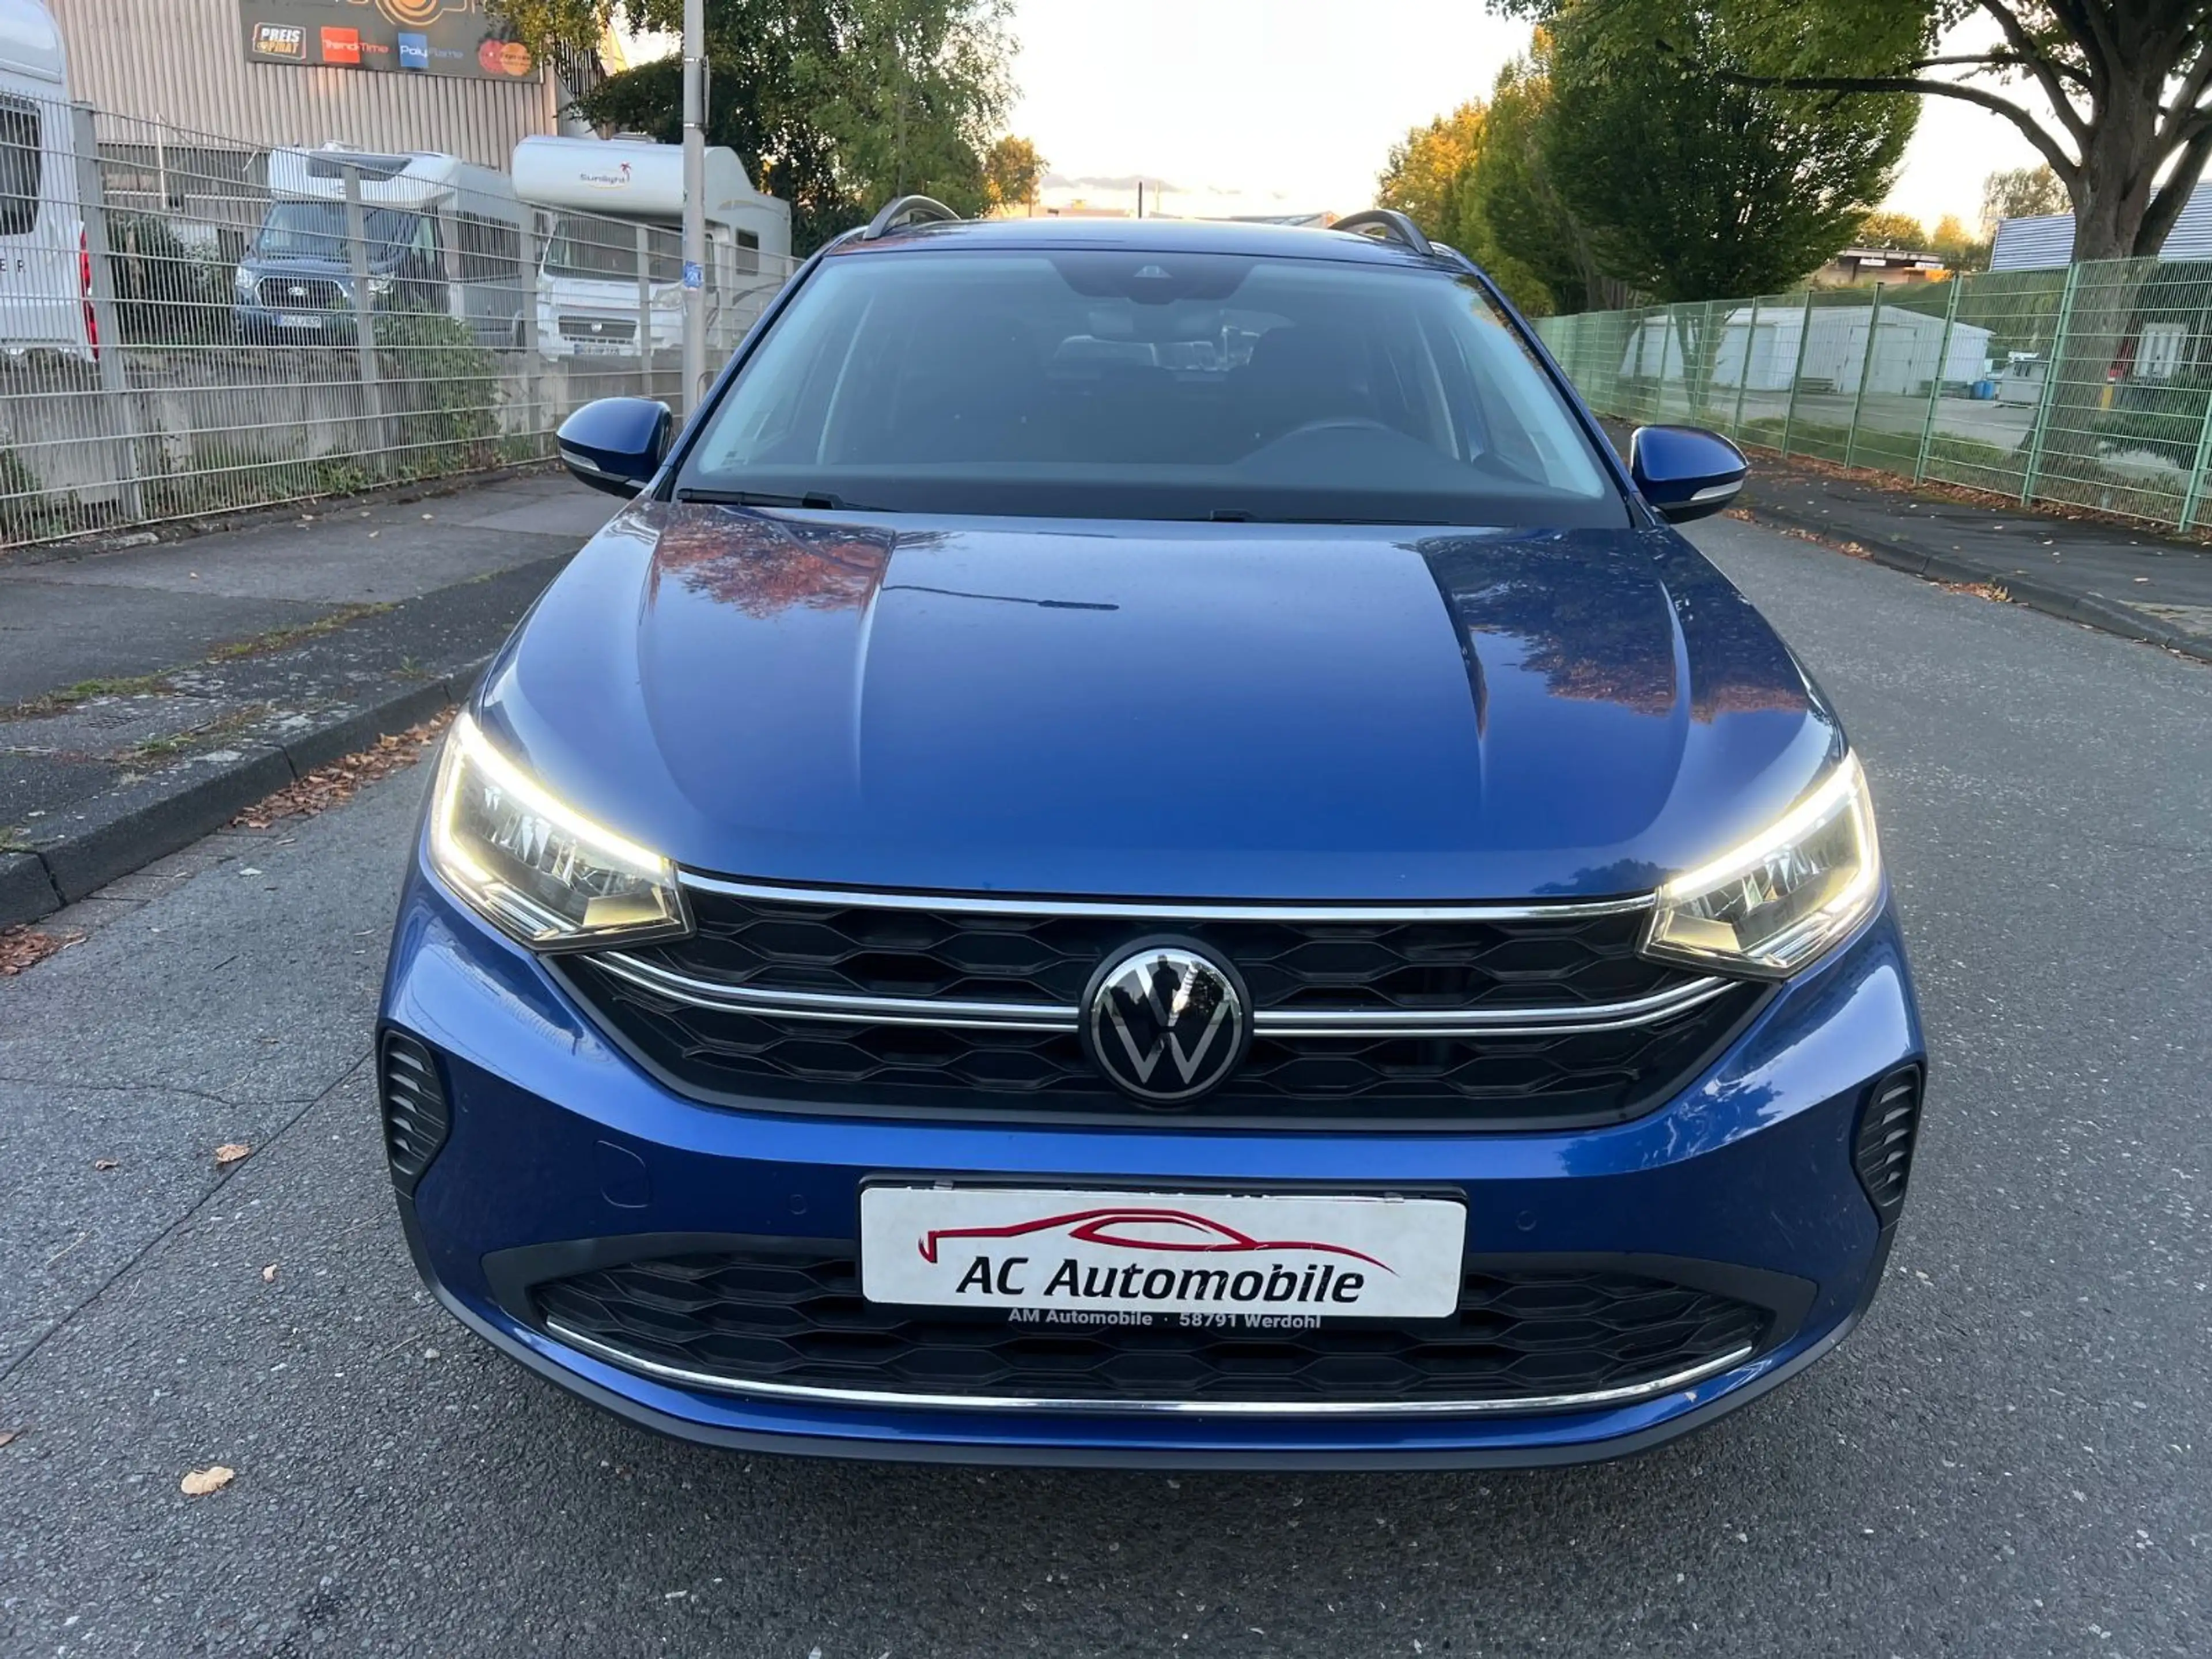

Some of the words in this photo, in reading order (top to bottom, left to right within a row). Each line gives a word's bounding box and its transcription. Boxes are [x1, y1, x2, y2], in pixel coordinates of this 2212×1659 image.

[261, 27, 301, 43] PREIS
[269, 41, 299, 54] PIRAT
[579, 172, 625, 185] Sunlight
[1097, 956, 1236, 1089] VW
[955, 1256, 1029, 1296] AC
[1043, 1258, 1364, 1304] Automobile
[1008, 1308, 1040, 1323] AM
[1045, 1309, 1153, 1325] Automobile
[1179, 1313, 1237, 1327] 58791
[1244, 1315, 1321, 1329] Werdohl
